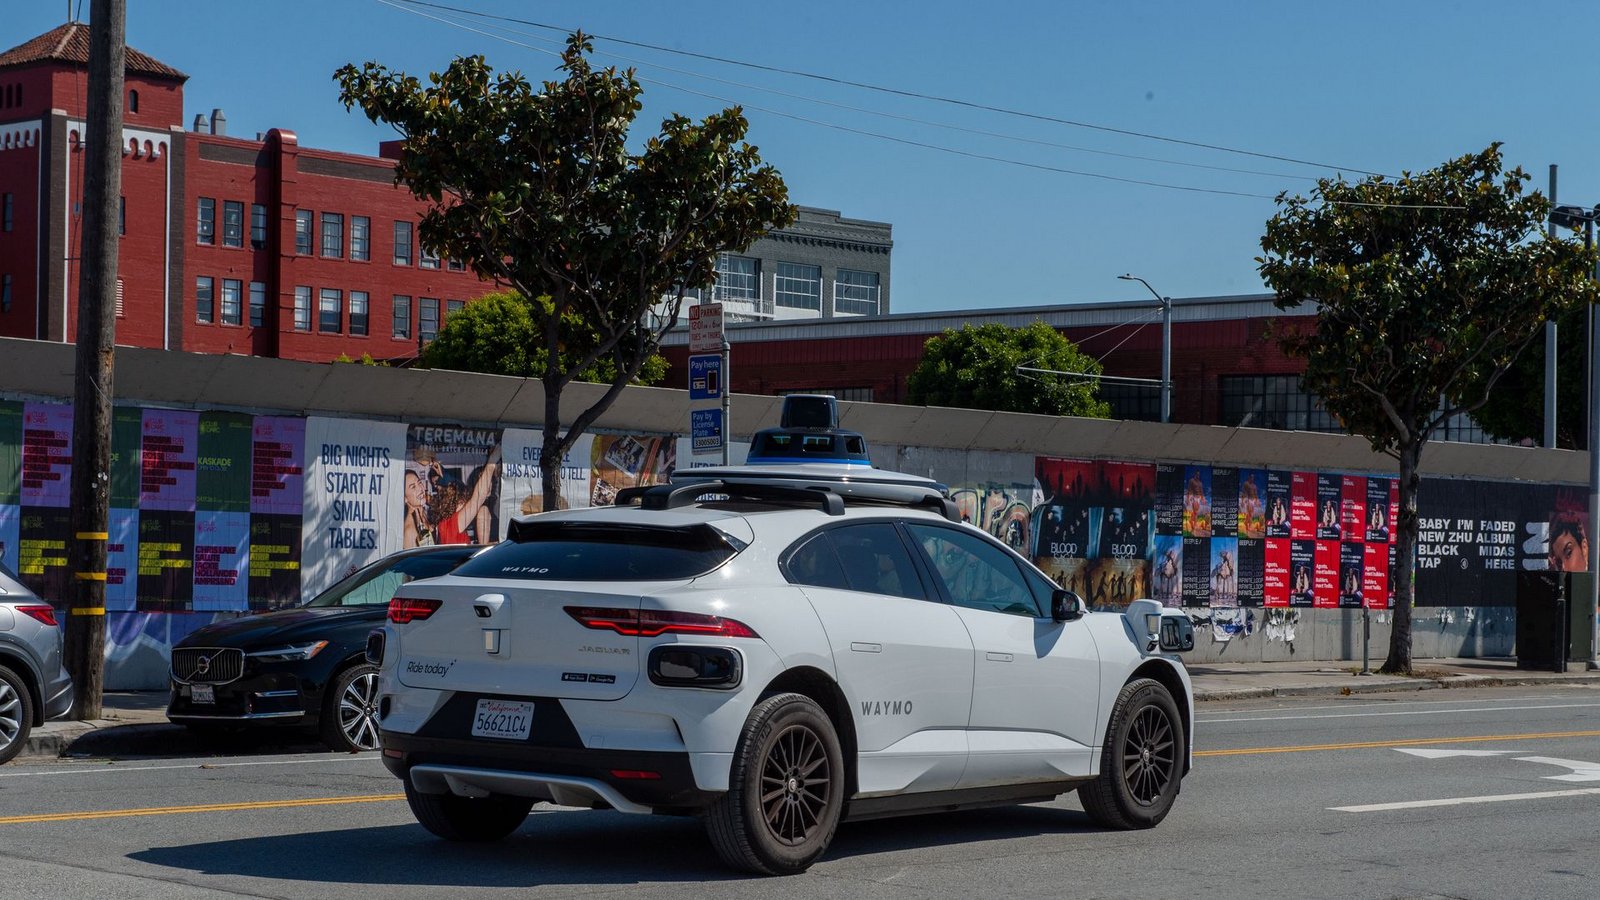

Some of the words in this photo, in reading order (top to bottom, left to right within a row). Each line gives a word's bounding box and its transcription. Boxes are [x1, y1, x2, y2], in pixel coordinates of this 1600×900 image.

[691, 361, 703, 371] Pay
[704, 359, 719, 368] here
[693, 413, 704, 422] Pay
[705, 412, 713, 421] by
[693, 421, 715, 429] License
[414, 427, 496, 446] TEREMANA
[693, 429, 709, 437] Plate
[198, 457, 232, 466] KASKADE
[321, 443, 342, 466] BIG
[345, 445, 390, 468] NIGHTS
[506, 464, 522, 478] HAS
[524, 465, 529, 478] A
[568, 467, 586, 480] TELL.
[326, 472, 366, 494] START
[369, 474, 384, 495] AT
[333, 500, 375, 522] SMALL
[1419, 518, 1450, 530] BABY
[1457, 519, 1473, 530] I'M
[1480, 520, 1516, 532] FADED
[329, 528, 377, 549] TABLES.
[1418, 531, 1445, 543] NEW
[1448, 532, 1472, 543] ZHU
[1475, 533, 1515, 544] ALBUM
[195, 546, 217, 554] CHRIS
[1051, 542, 1077, 554] BLOOD
[1112, 543, 1137, 555] BLOOD
[1418, 544, 1459, 555] BLACK
[1479, 546, 1515, 556] MIDAS
[1418, 557, 1441, 568] TAP
[1485, 559, 1515, 569] HERE
[195, 569, 238, 577] HOLLANDER
[501, 566, 549, 574] WAYMO
[578, 646, 631, 655] JAGUAR
[407, 661, 423, 673] Ride
[425, 662, 449, 678] today
[861, 700, 913, 716] WAYMO
[477, 713, 526, 733] 56621C4
